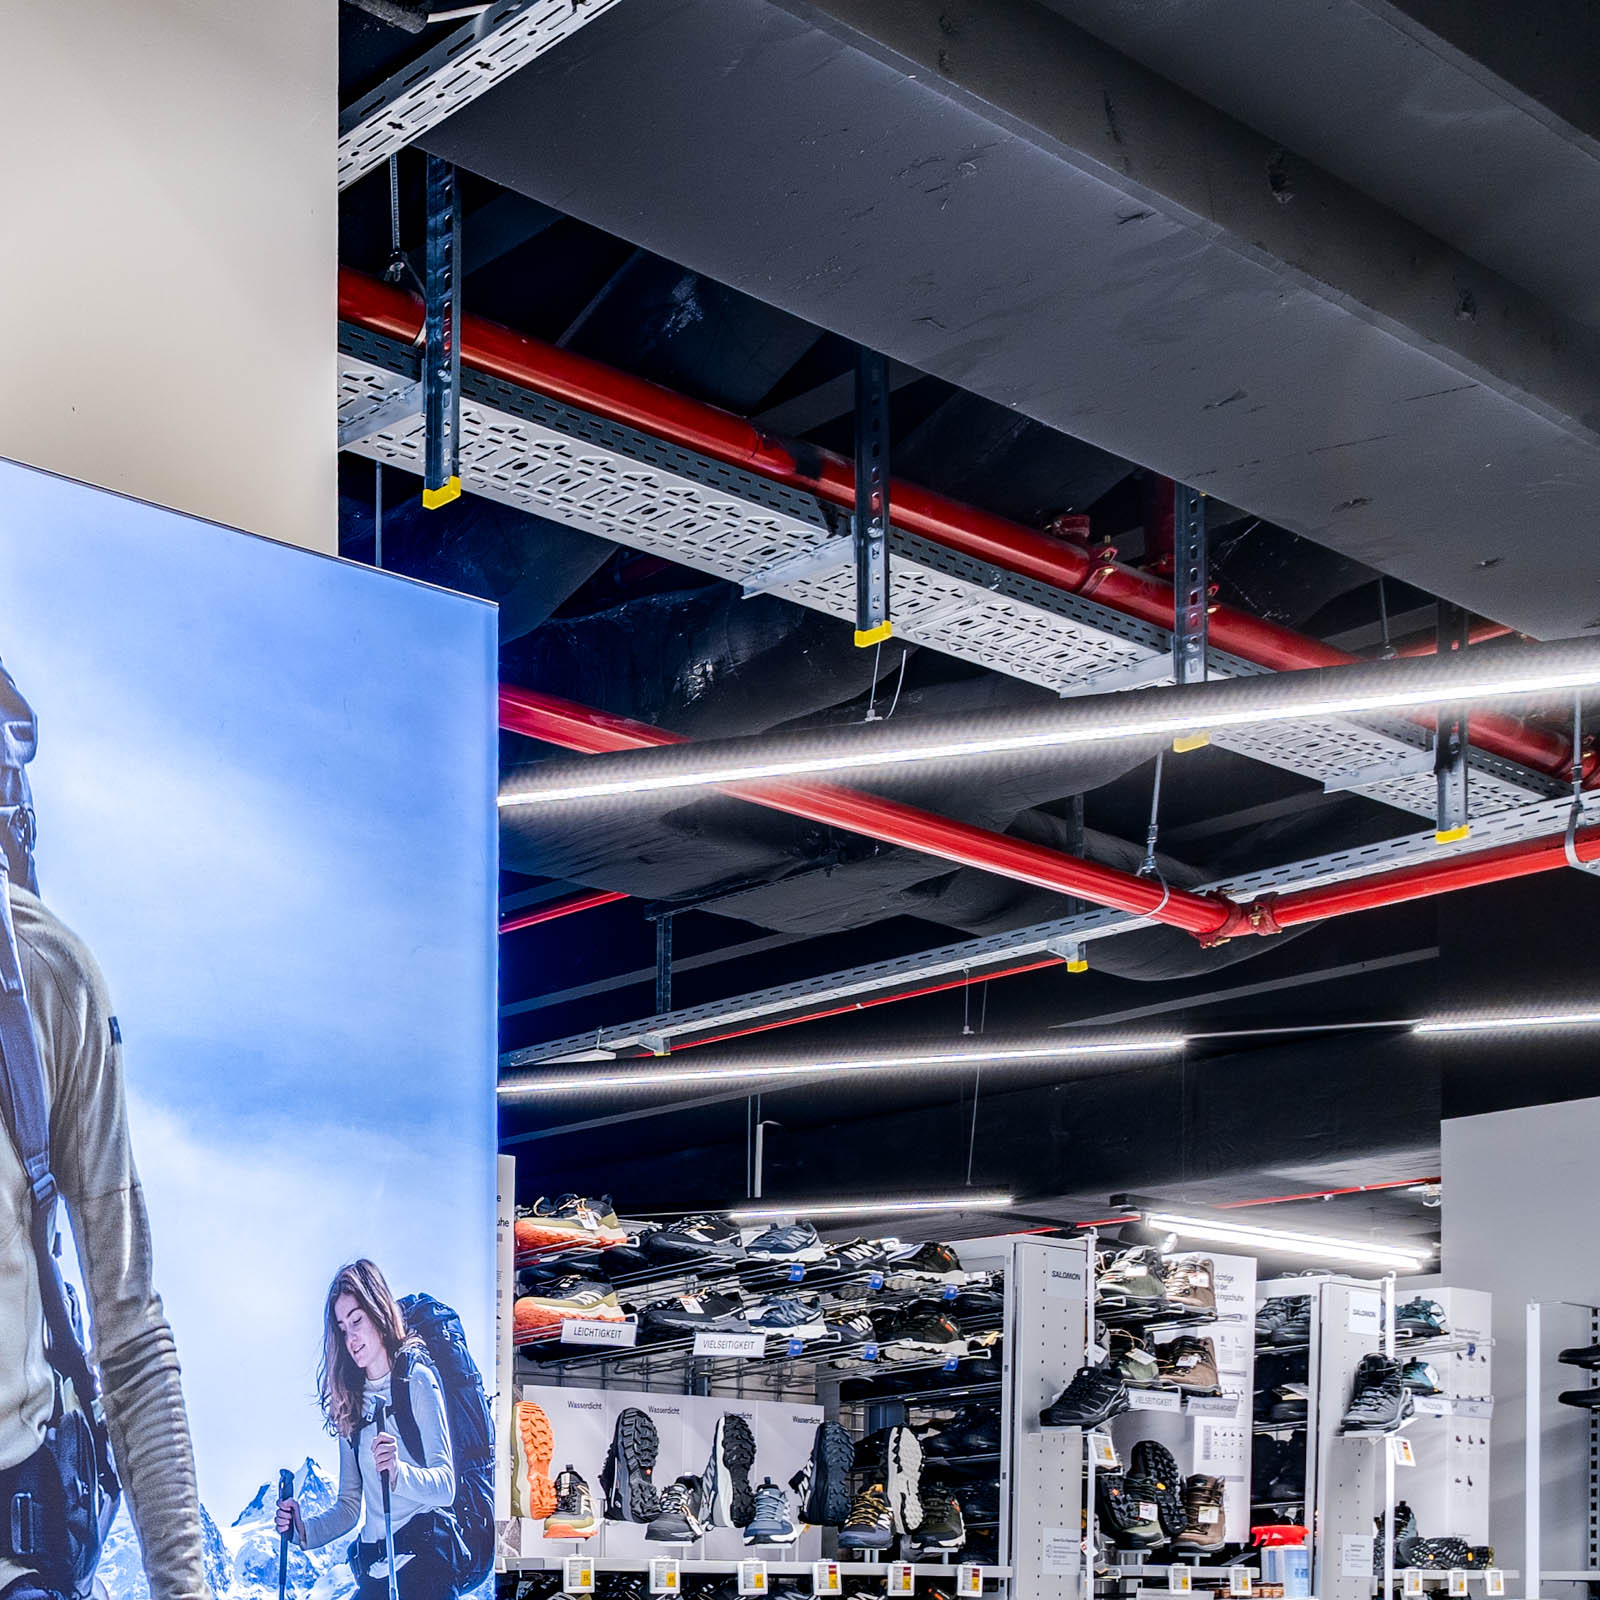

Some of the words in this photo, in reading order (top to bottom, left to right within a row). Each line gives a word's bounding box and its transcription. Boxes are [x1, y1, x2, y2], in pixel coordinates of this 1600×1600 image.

[1051, 1270, 1081, 1281] SALOMON
[573, 1326, 623, 1339] LEICHTIGKEIT
[702, 1339, 755, 1351] VIELSEITIGKEIT
[567, 1400, 603, 1411] Wasserdicht
[648, 1405, 681, 1415] Wasserdicht
